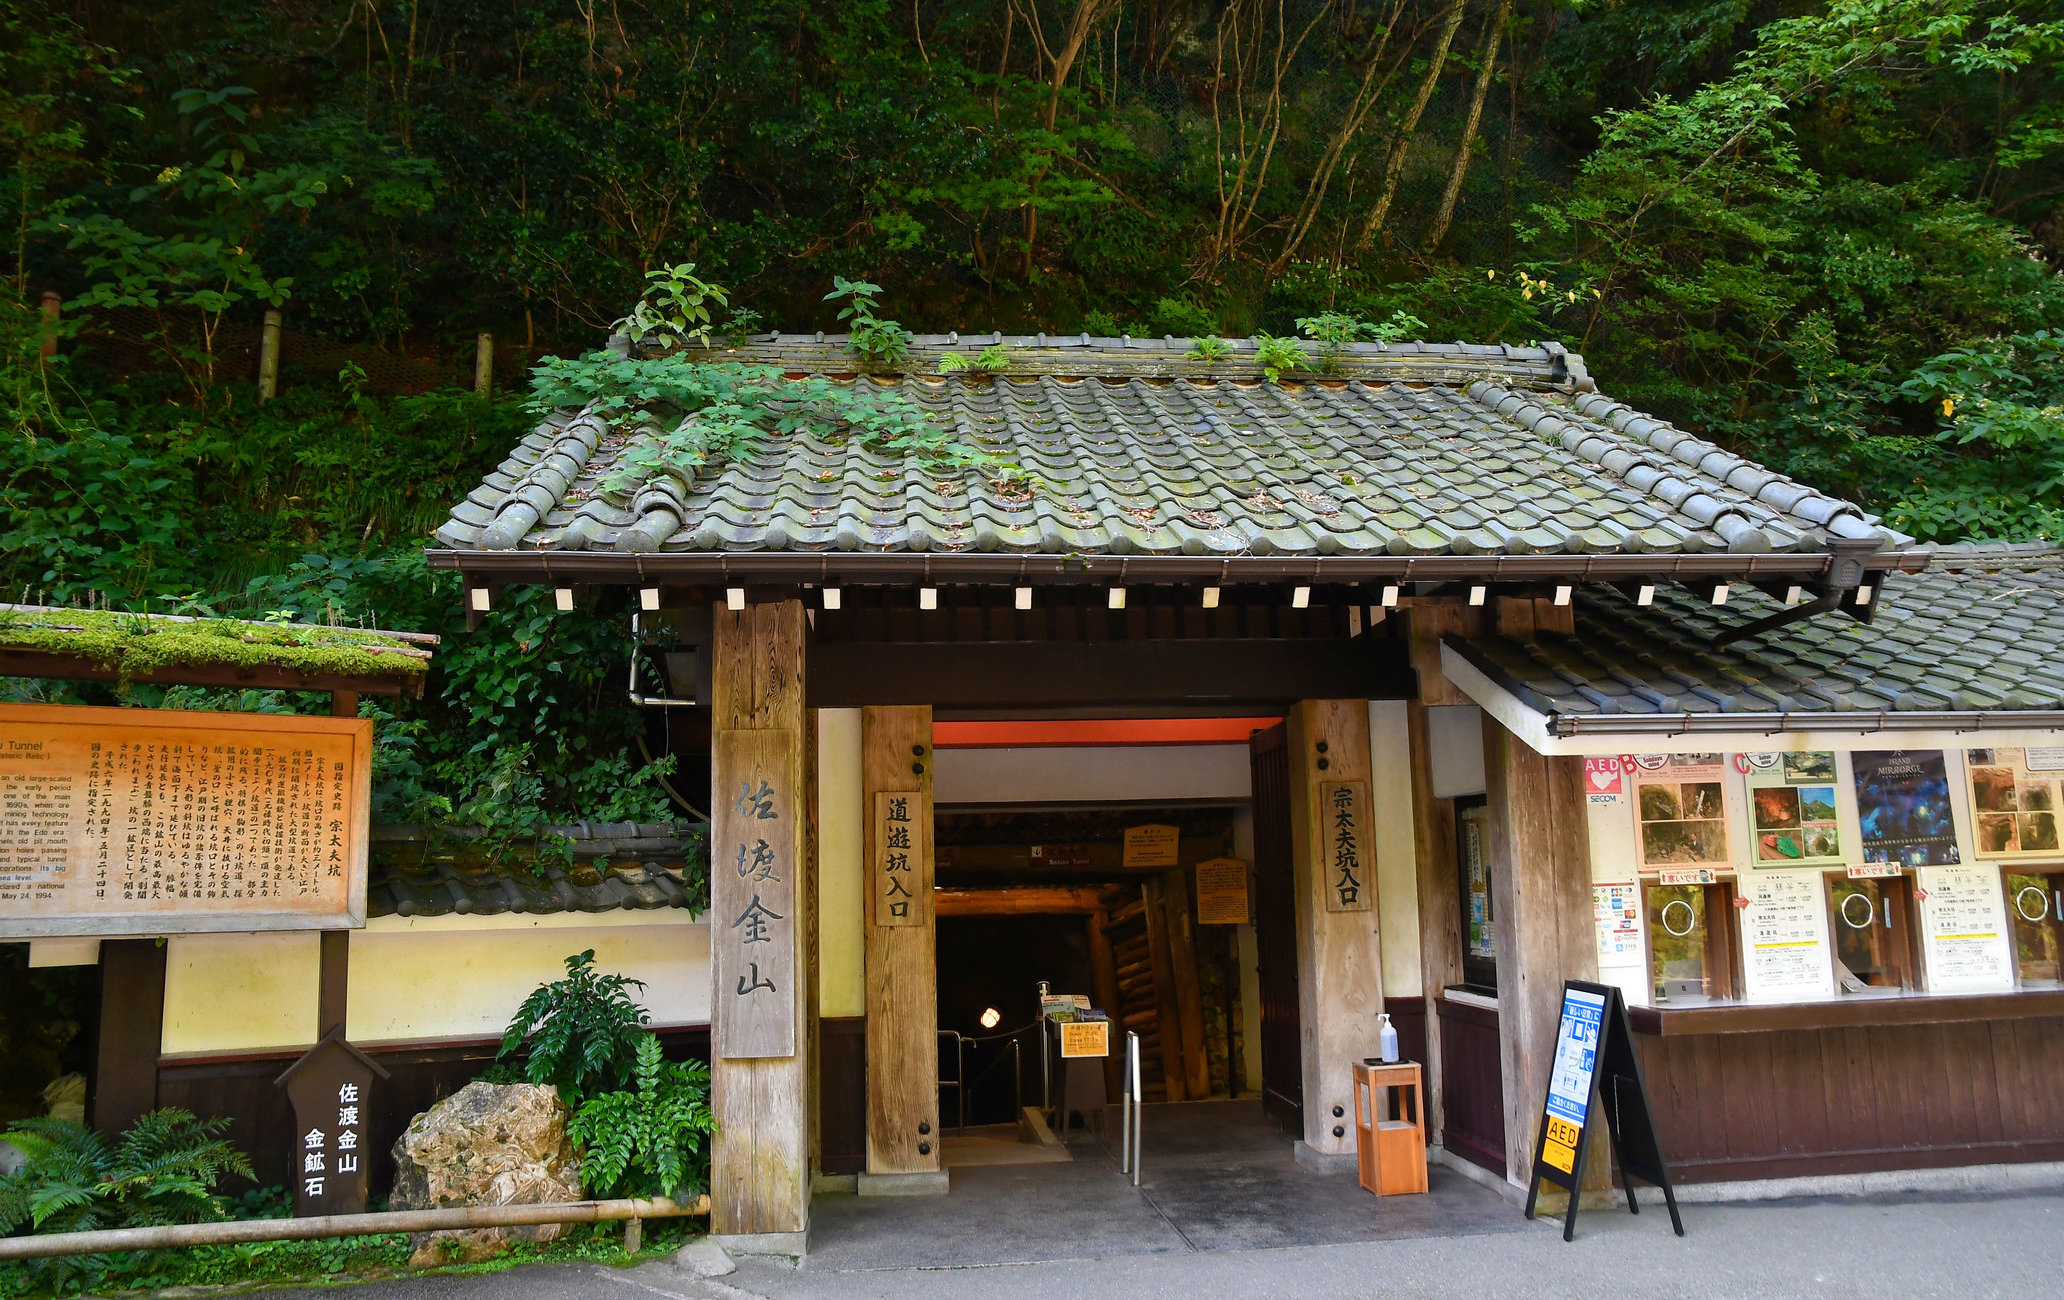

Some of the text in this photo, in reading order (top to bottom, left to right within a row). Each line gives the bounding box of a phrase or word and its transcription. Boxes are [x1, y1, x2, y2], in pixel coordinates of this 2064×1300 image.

[9, 741, 42, 751] Tunnel
[1585, 759, 1619, 771] AED
[1620, 754, 1637, 775] B
[1733, 753, 1751, 775] C
[1889, 757, 1911, 765] ISLAND
[30, 775, 72, 783] large-scaled
[1590, 795, 1616, 803] SECOM
[327, 819, 343, 877] 宗太夫坑
[885, 797, 912, 917] 道遊坑入口
[1333, 786, 1361, 906] 宗太夫坑入口
[732, 780, 785, 996] 佐渡金山
[338, 1083, 359, 1174] 佐渡金山
[1549, 1122, 1577, 1144] AED
[304, 1128, 326, 1197] 金鉱石
